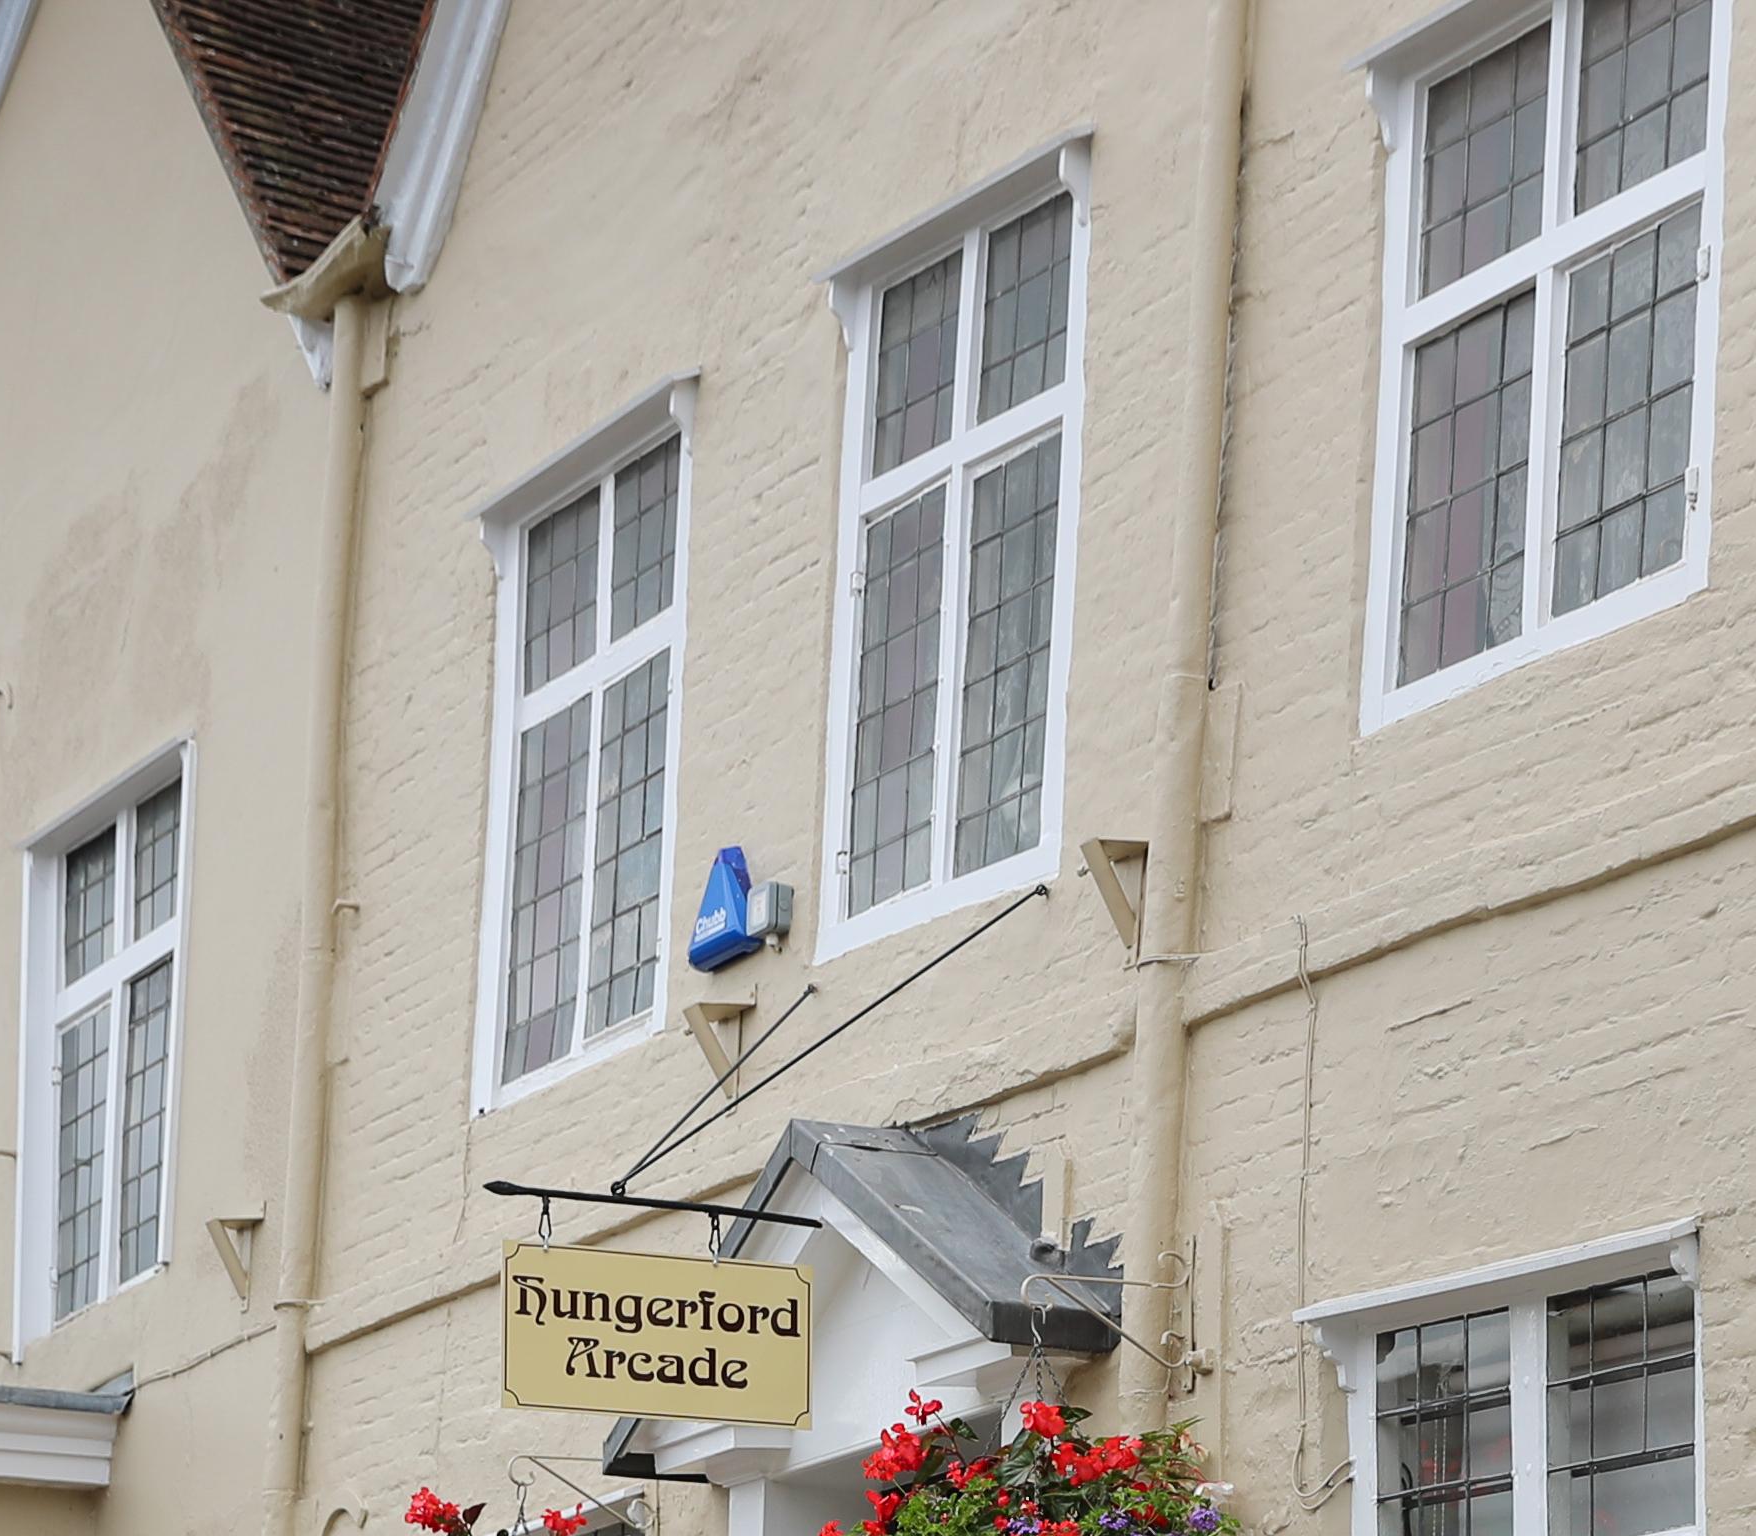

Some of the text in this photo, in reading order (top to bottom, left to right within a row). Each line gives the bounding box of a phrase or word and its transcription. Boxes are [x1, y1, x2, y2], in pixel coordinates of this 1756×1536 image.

[695, 906, 727, 935] Chubb
[511, 1274, 802, 1338] Hungerford
[565, 1336, 749, 1389] Arcade
